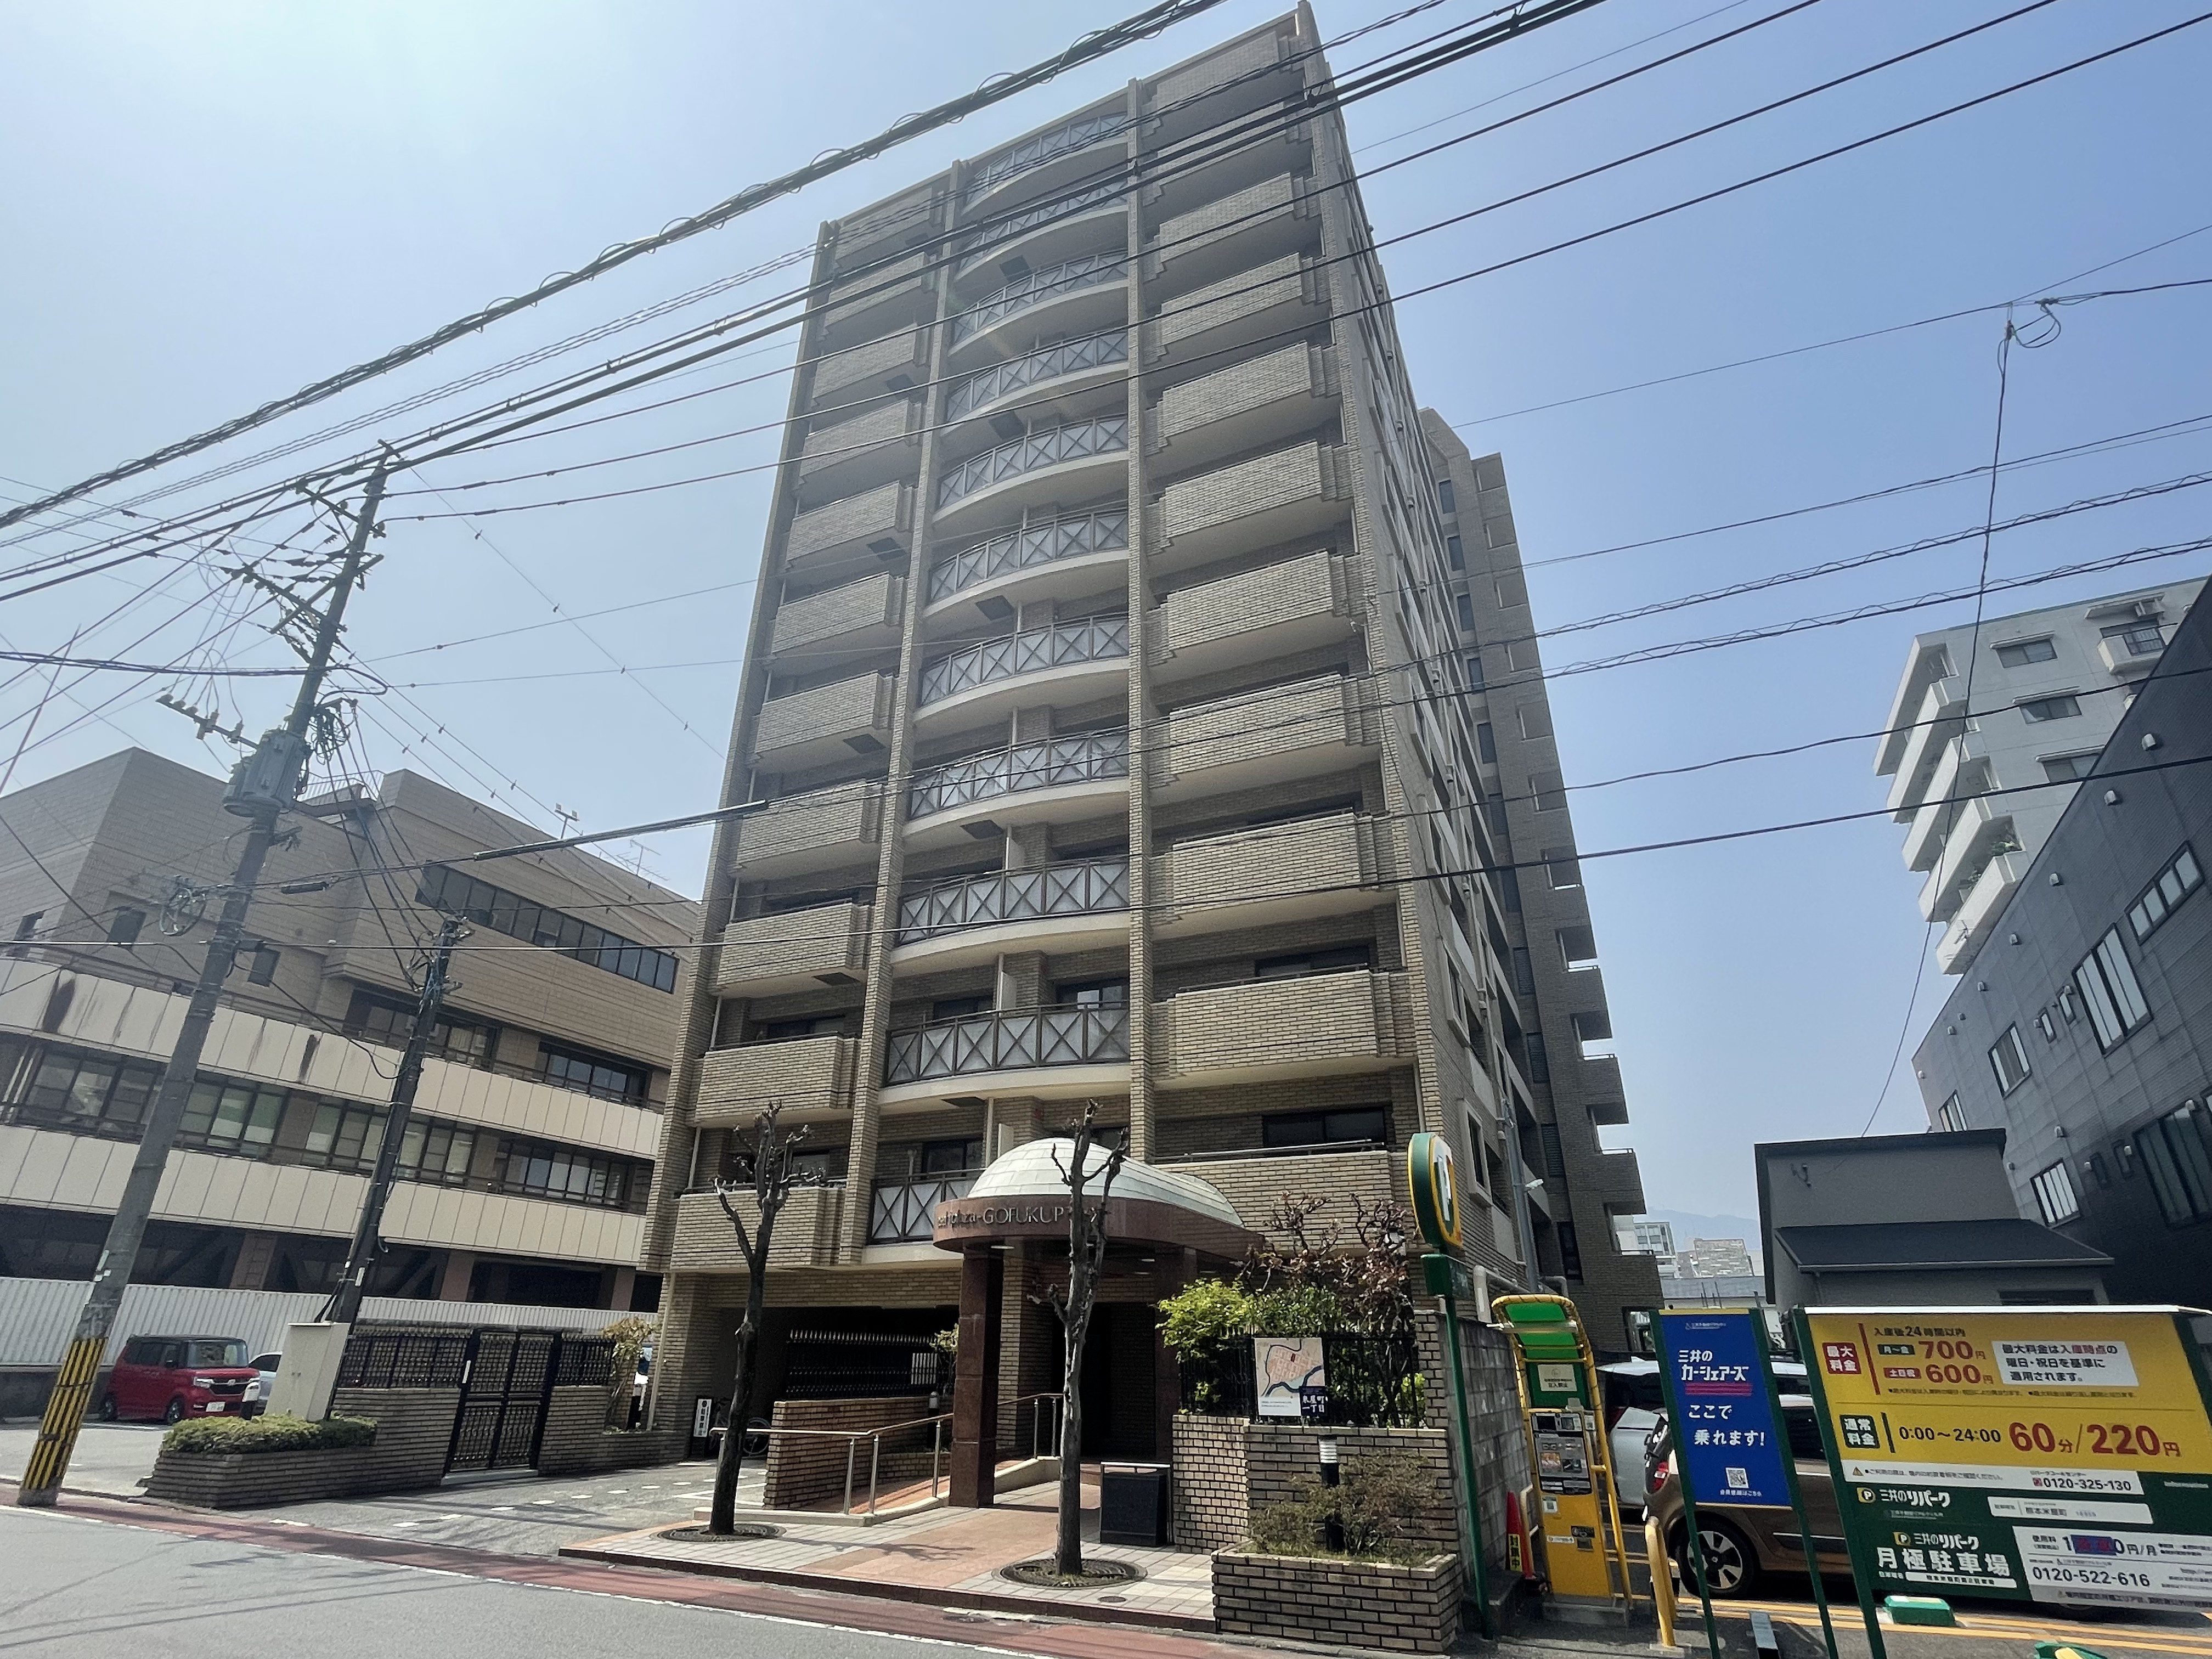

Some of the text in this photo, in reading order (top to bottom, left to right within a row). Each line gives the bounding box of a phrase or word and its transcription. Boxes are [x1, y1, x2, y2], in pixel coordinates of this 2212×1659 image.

[1678, 1350, 1713, 1363] 三井の
[1826, 1346, 1854, 1358] 最大
[1918, 1341, 1987, 1360] 700円
[1681, 1364, 1750, 1381] カーシェアーズ
[1829, 1359, 1857, 1372] 料金
[1925, 1364, 1994, 1385] 600円
[1688, 1404, 1733, 1420] ここで
[1844, 1418, 1872, 1431] 通常
[1847, 1432, 1876, 1446] 料金
[2042, 1477, 2132, 1491] 0120-325-130
[1879, 1489, 1951, 1508] 三井のリパーク
[1913, 1533, 1980, 1550] 三井のリパーク
[1876, 1547, 2011, 1577] 月極駐車場
[2032, 1566, 2151, 1587] 0120-522-616
